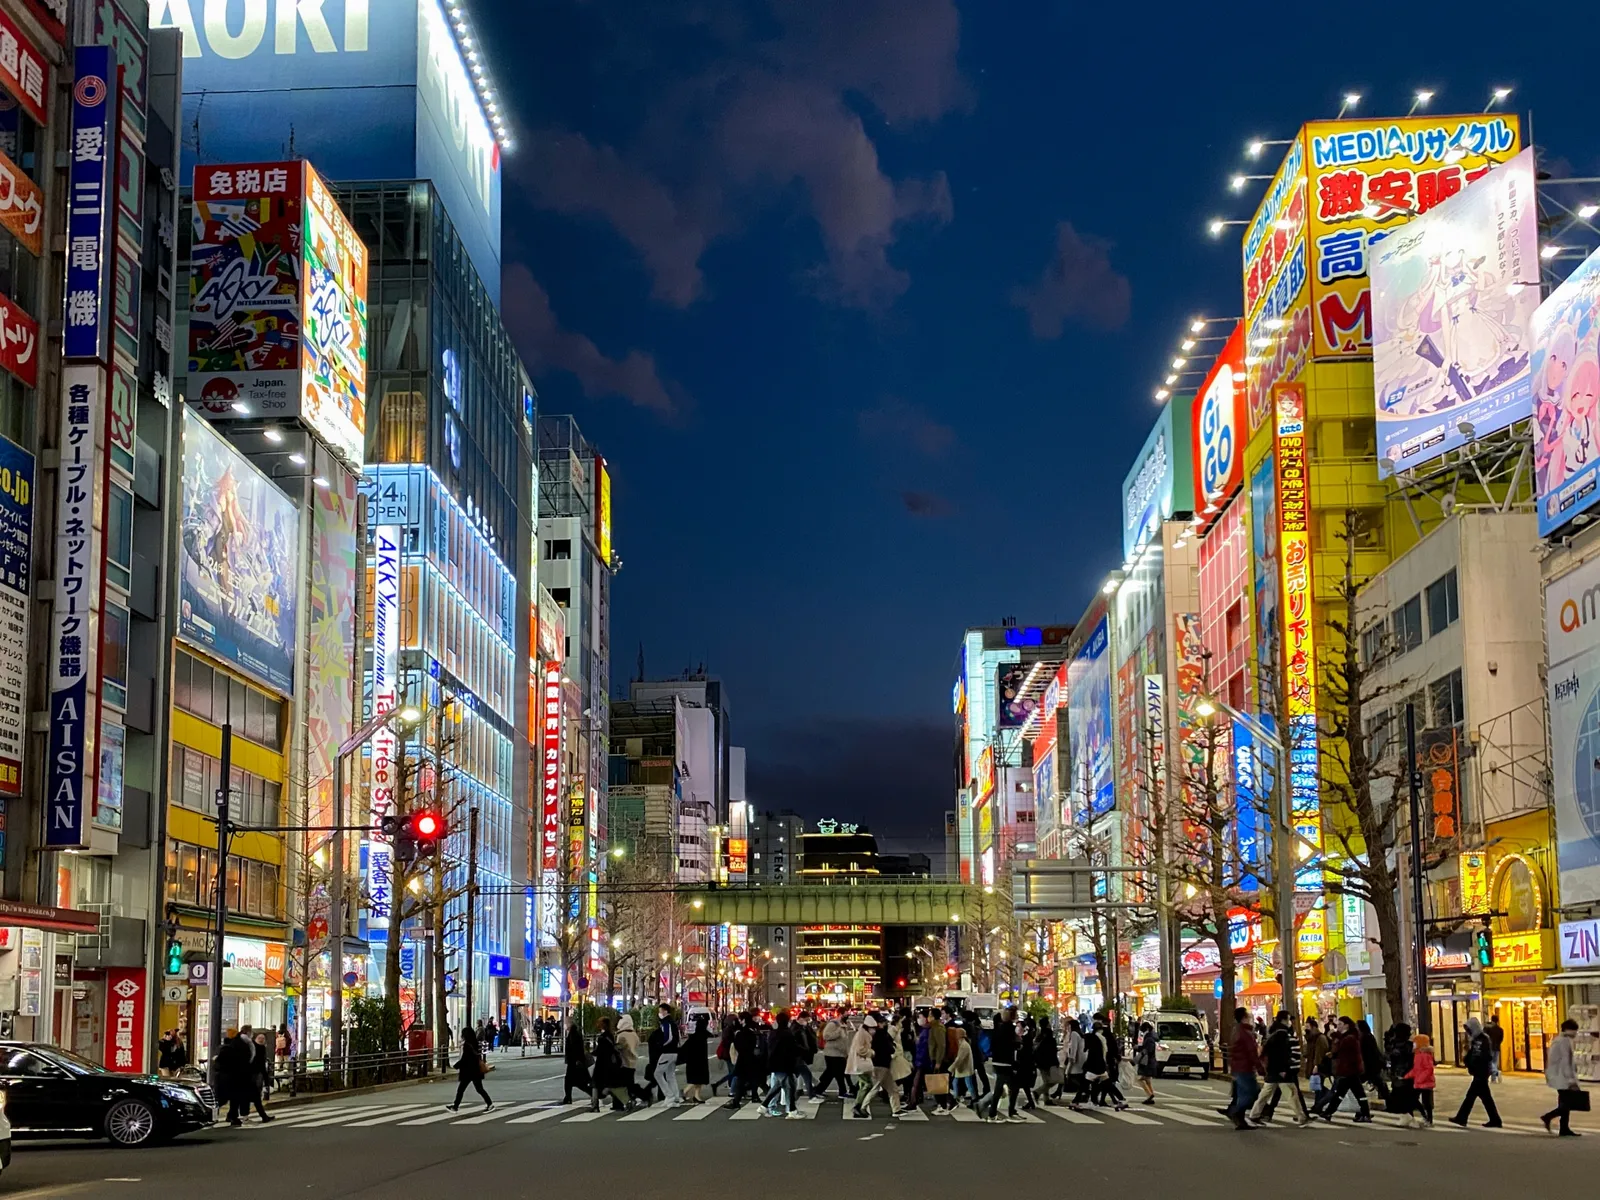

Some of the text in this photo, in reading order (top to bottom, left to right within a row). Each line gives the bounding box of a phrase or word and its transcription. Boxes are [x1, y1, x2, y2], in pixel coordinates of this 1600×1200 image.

[149, 0, 368, 59] AOKI
[1314, 119, 1512, 167] MEDIAリサイクル
[209, 168, 288, 195] 免税店
[1319, 167, 1491, 218] 激安販
[68, 126, 103, 327] 愛三電機
[252, 378, 286, 388] Japan.
[248, 390, 286, 399] Tax-free
[262, 401, 286, 410] Shop
[1281, 438, 1301, 447] DVD
[1280, 448, 1302, 457] ブルーレイ
[1281, 459, 1303, 468] ゲーム
[1285, 469, 1300, 478] CD
[1281, 480, 1303, 489] アイドル
[1282, 490, 1304, 499] アニメ
[368, 507, 407, 518] OPEN
[1283, 501, 1304, 510] コミック
[1284, 511, 1304, 520] ホビー
[59, 384, 89, 677] 各種ケーブル・ネットワーク機器
[1284, 522, 1305, 531] フィギュア
[378, 535, 397, 608] AKKY
[376, 595, 388, 687] INTERNATIONAL
[1555, 669, 1580, 701] 原神
[1147, 679, 1163, 730] AKKY
[374, 690, 395, 783] Ta-free
[54, 697, 78, 829] AISAN
[545, 748, 558, 805] カラオケ
[545, 814, 557, 858] パセラ
[1300, 934, 1323, 942] AKIBA
[237, 957, 262, 969] mobile
[267, 956, 283, 970] au
[115, 999, 135, 1067] 坂口電熱
